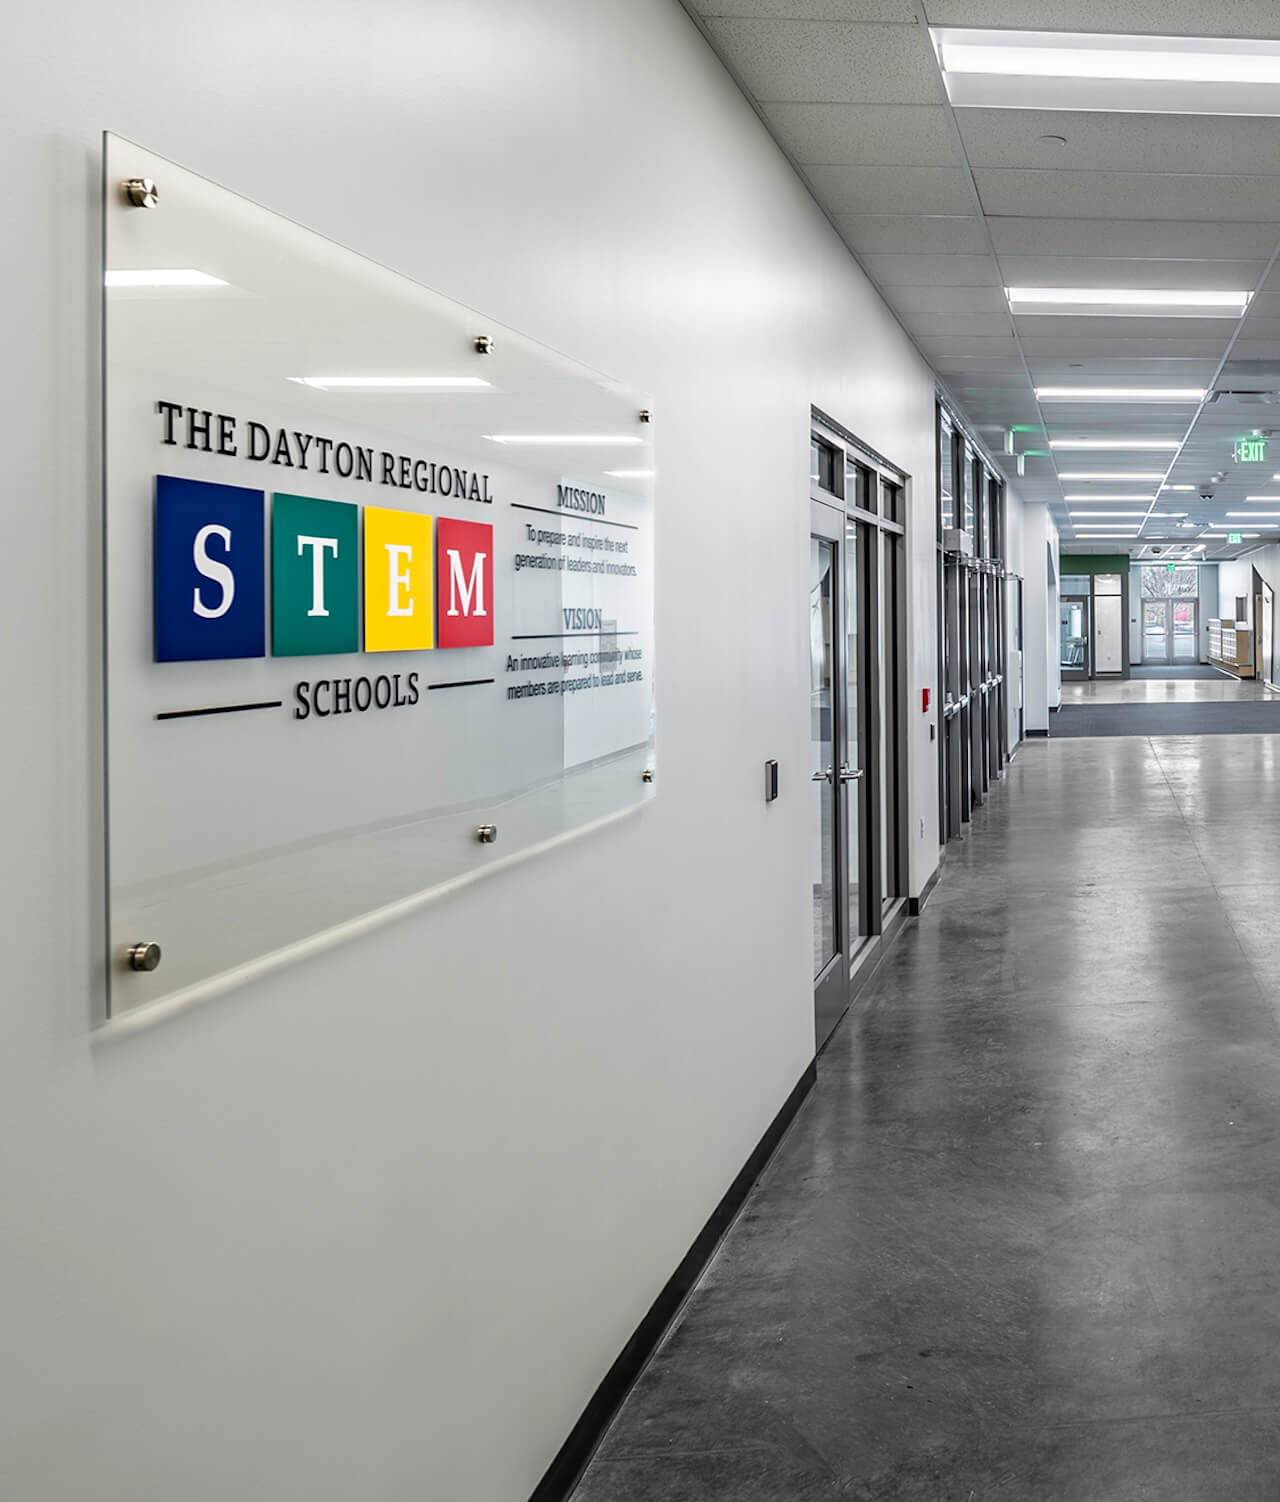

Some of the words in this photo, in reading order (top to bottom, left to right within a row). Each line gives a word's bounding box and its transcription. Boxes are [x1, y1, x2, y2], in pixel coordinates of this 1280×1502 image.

[158, 400, 237, 458] THE
[247, 421, 374, 483] DAYTON
[381, 452, 494, 505] REGIONAL
[1241, 442, 1265, 462] EXIT
[557, 485, 606, 516] MISSION
[525, 523, 536, 541] To
[537, 529, 566, 547] prepare
[567, 532, 580, 546] and
[582, 533, 603, 552] inspire
[604, 536, 615, 552] the
[615, 540, 628, 553] next
[515, 553, 556, 571] generation
[558, 555, 566, 570] of
[567, 556, 592, 573] leaders
[592, 559, 604, 574] and
[563, 608, 602, 631] VISION
[506, 655, 519, 672] An
[520, 652, 560, 671] innovative
[561, 650, 588, 668] learning
[296, 673, 420, 720] SCHOOLS
[507, 680, 546, 700] members
[547, 681, 560, 695] are
[561, 675, 592, 696] prepared
[593, 673, 599, 687] to
[601, 672, 613, 687] lead
[615, 670, 626, 684] and
